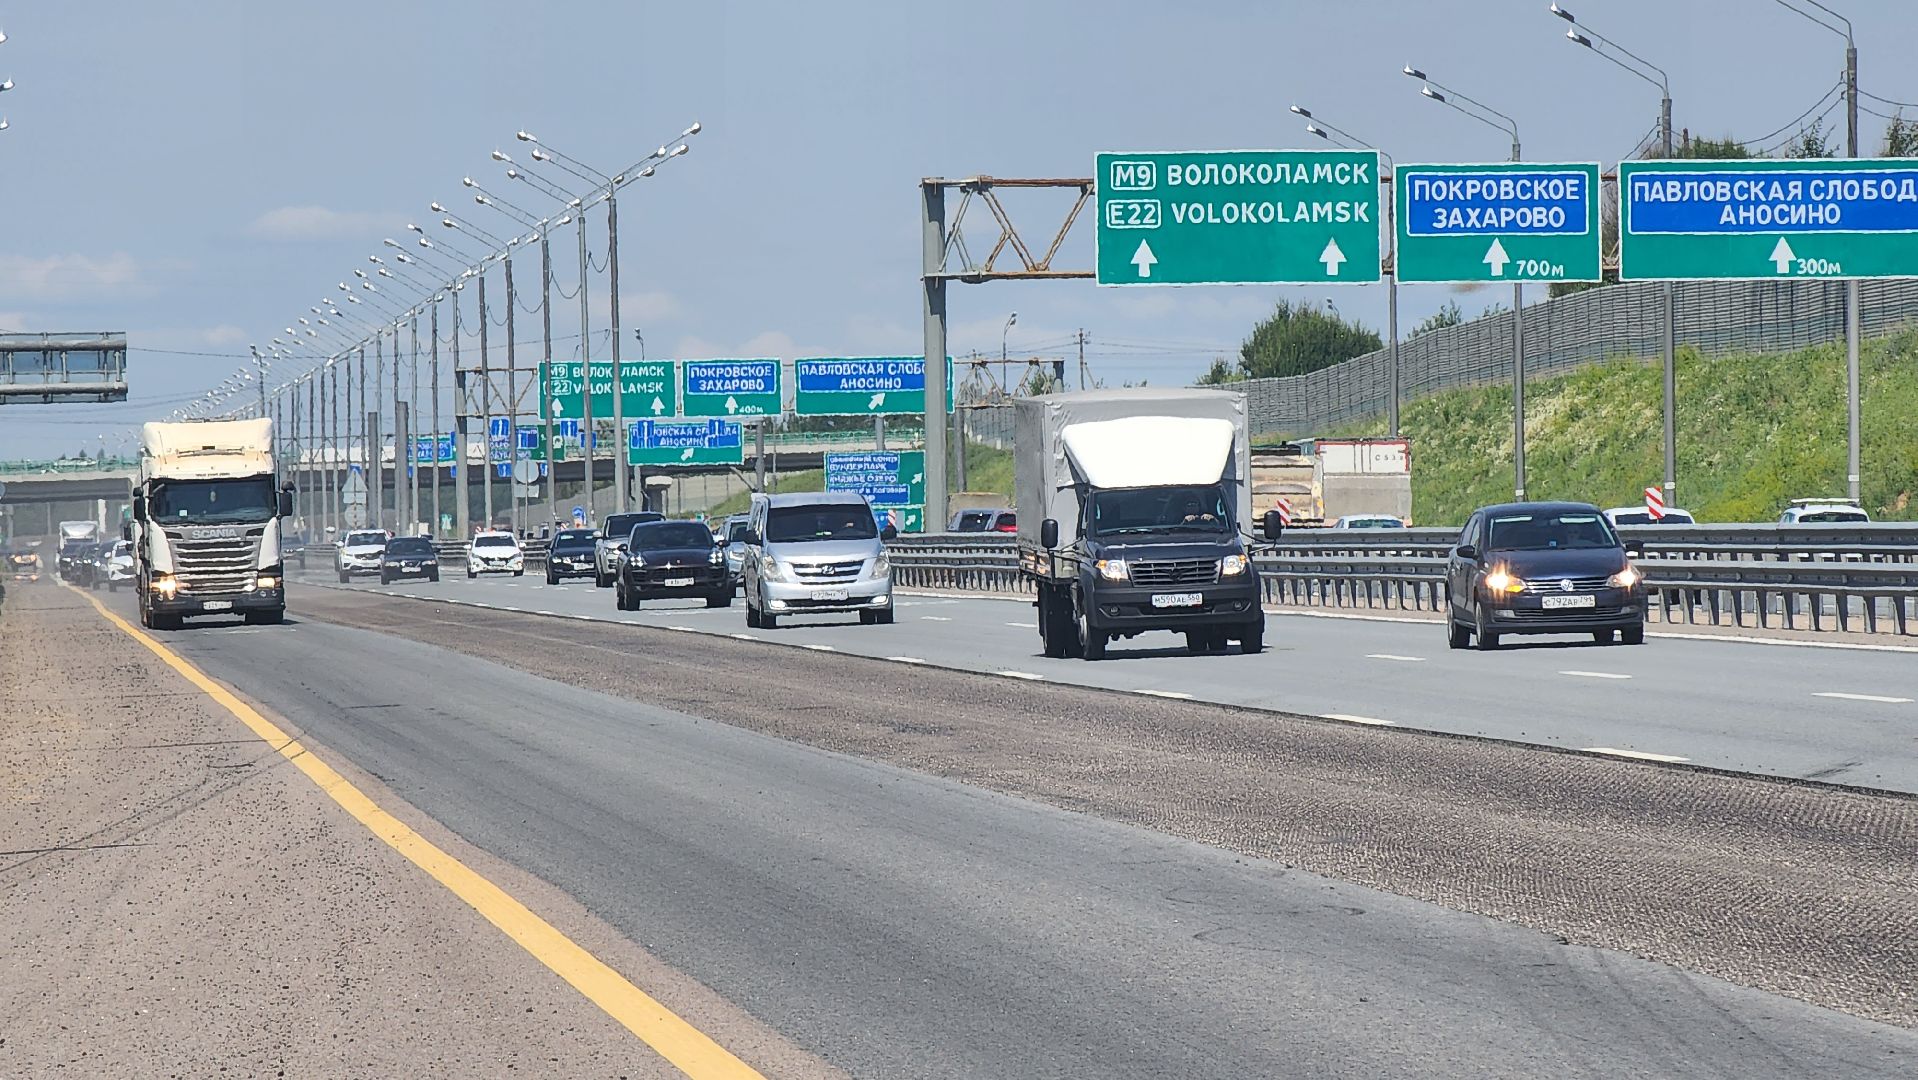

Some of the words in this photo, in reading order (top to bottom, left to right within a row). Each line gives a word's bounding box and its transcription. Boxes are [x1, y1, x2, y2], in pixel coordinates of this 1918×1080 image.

[1167, 162, 1370, 186] ВОЛОКОЛАМСК
[1413, 178, 1581, 201] ПОКРОВСКОЕ
[1633, 180, 1803, 203] ПАВЛОВСКАЯ
[1111, 203, 1157, 224] E22
[1171, 202, 1370, 224] VOLOKOLAMSK
[1432, 207, 1566, 229] ЗАХАРОВО
[1719, 203, 1842, 226] АНОСИНО
[572, 366, 665, 378] ВЛОКЛАМСК
[690, 365, 772, 379] ПОКРОВСКОЕ
[801, 362, 883, 376] ПАВЛОВСКАЯ
[573, 382, 664, 395] VLOKLAMSK
[699, 378, 765, 391] ЗАХАРОВО
[839, 377, 902, 390] АНОСИНО
[192, 528, 238, 539] SCANIA
